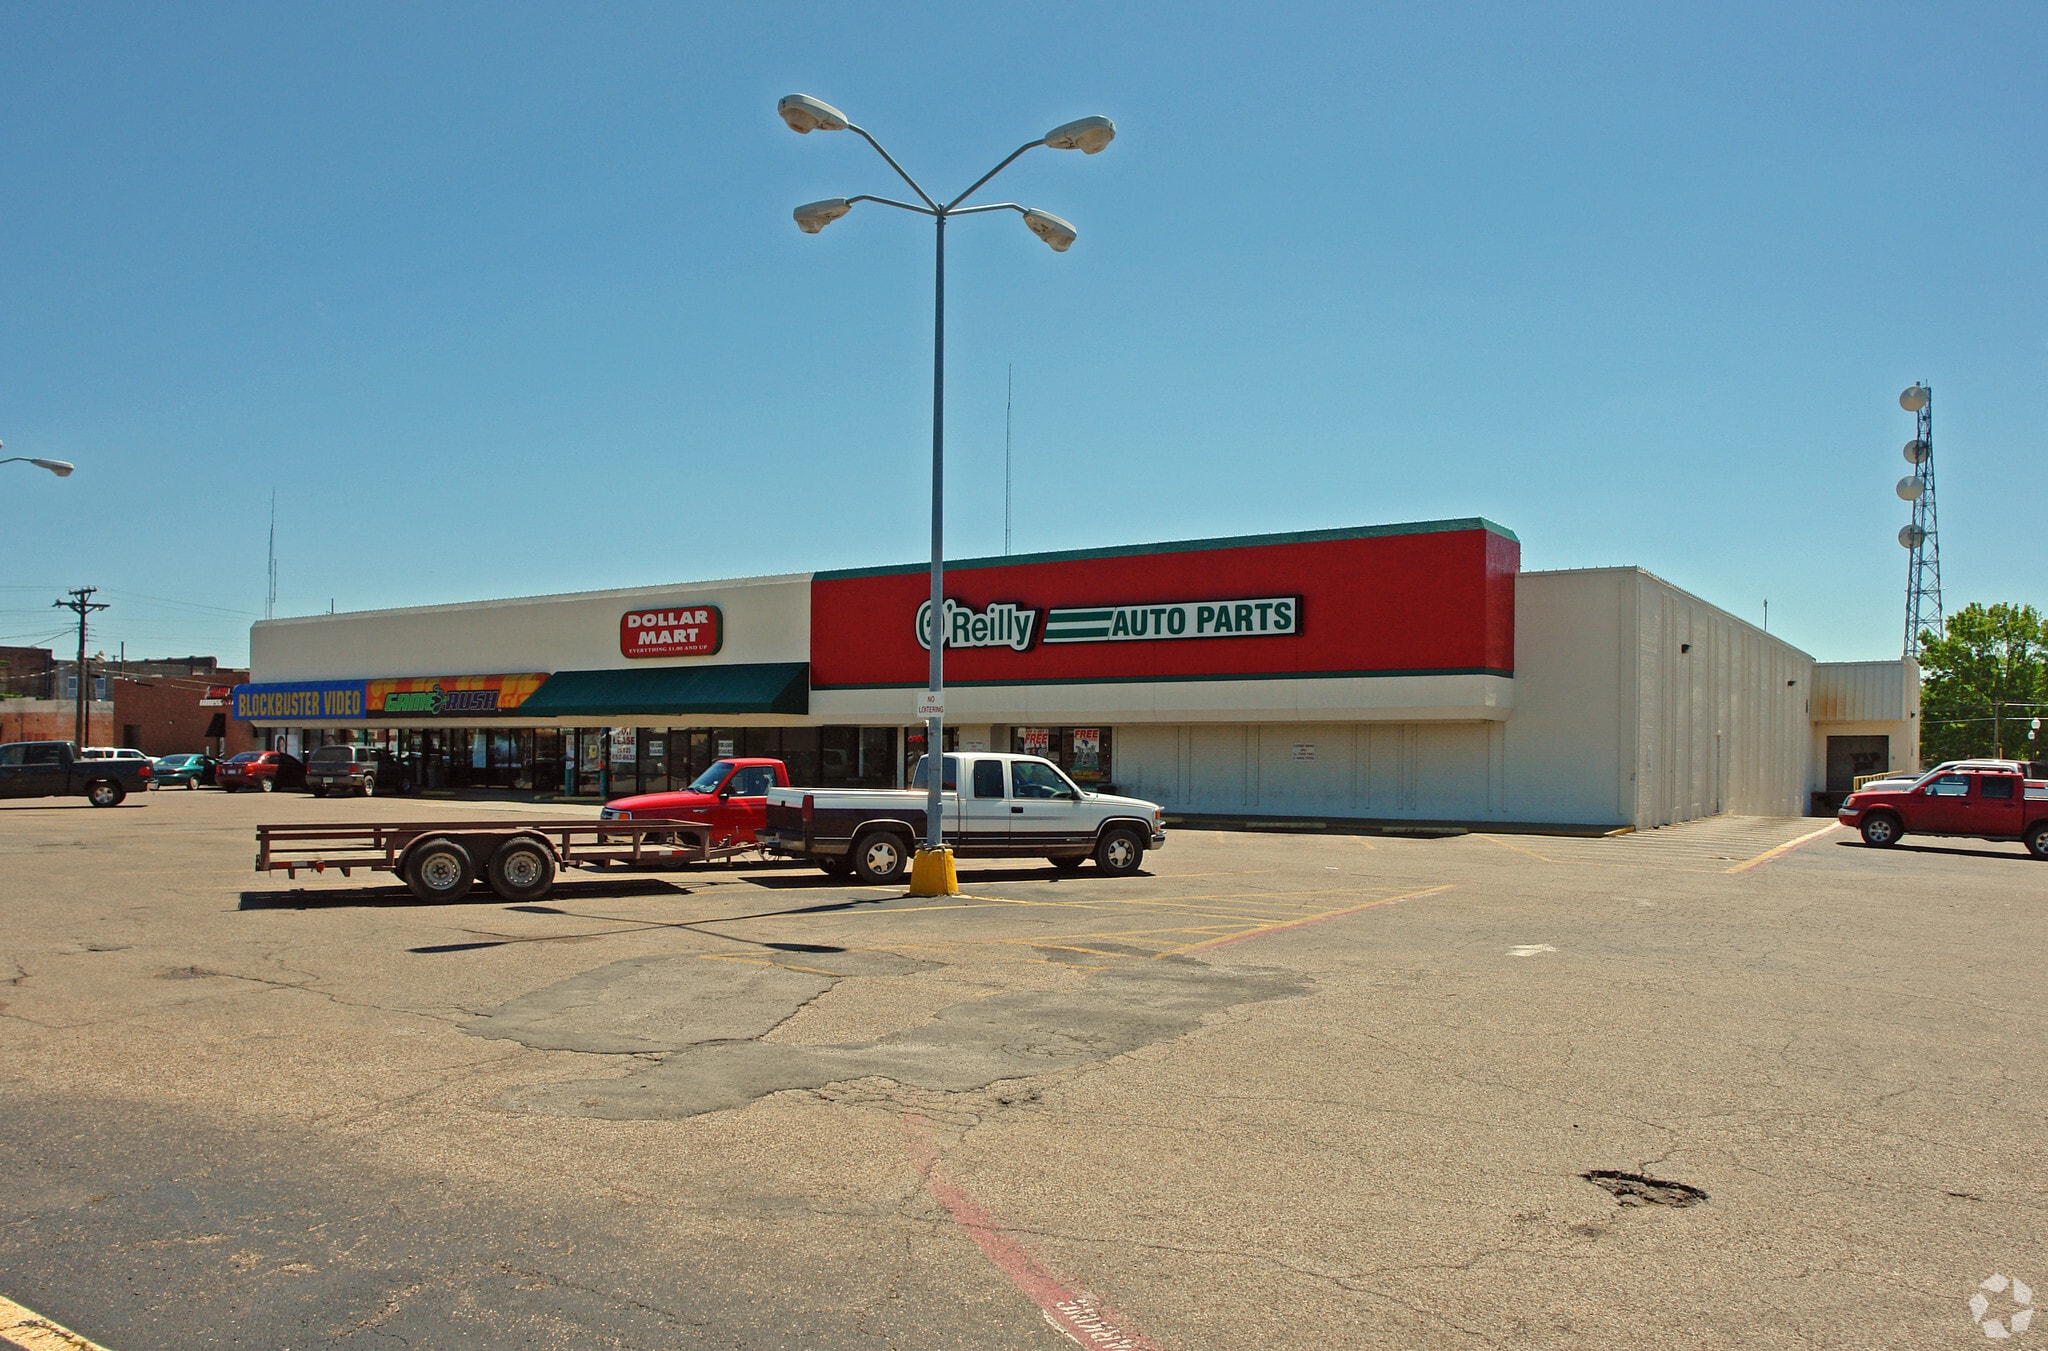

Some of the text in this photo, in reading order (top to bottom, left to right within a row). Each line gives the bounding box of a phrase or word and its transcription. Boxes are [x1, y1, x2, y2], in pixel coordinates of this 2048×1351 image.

[628, 610, 708, 628] DOLLAR
[1112, 601, 1292, 636] AUTO PARTS
[638, 628, 699, 645] MART
[238, 691, 319, 717] BLOCKBUSTER
[323, 690, 361, 715] VIDEO
[384, 690, 500, 712] GAME RUSH
[927, 695, 935, 703] NO
[918, 705, 944, 713] LOITERING
[612, 736, 635, 745] LEASE
[1024, 733, 1048, 745] FREE
[1074, 730, 1099, 739] FREE
